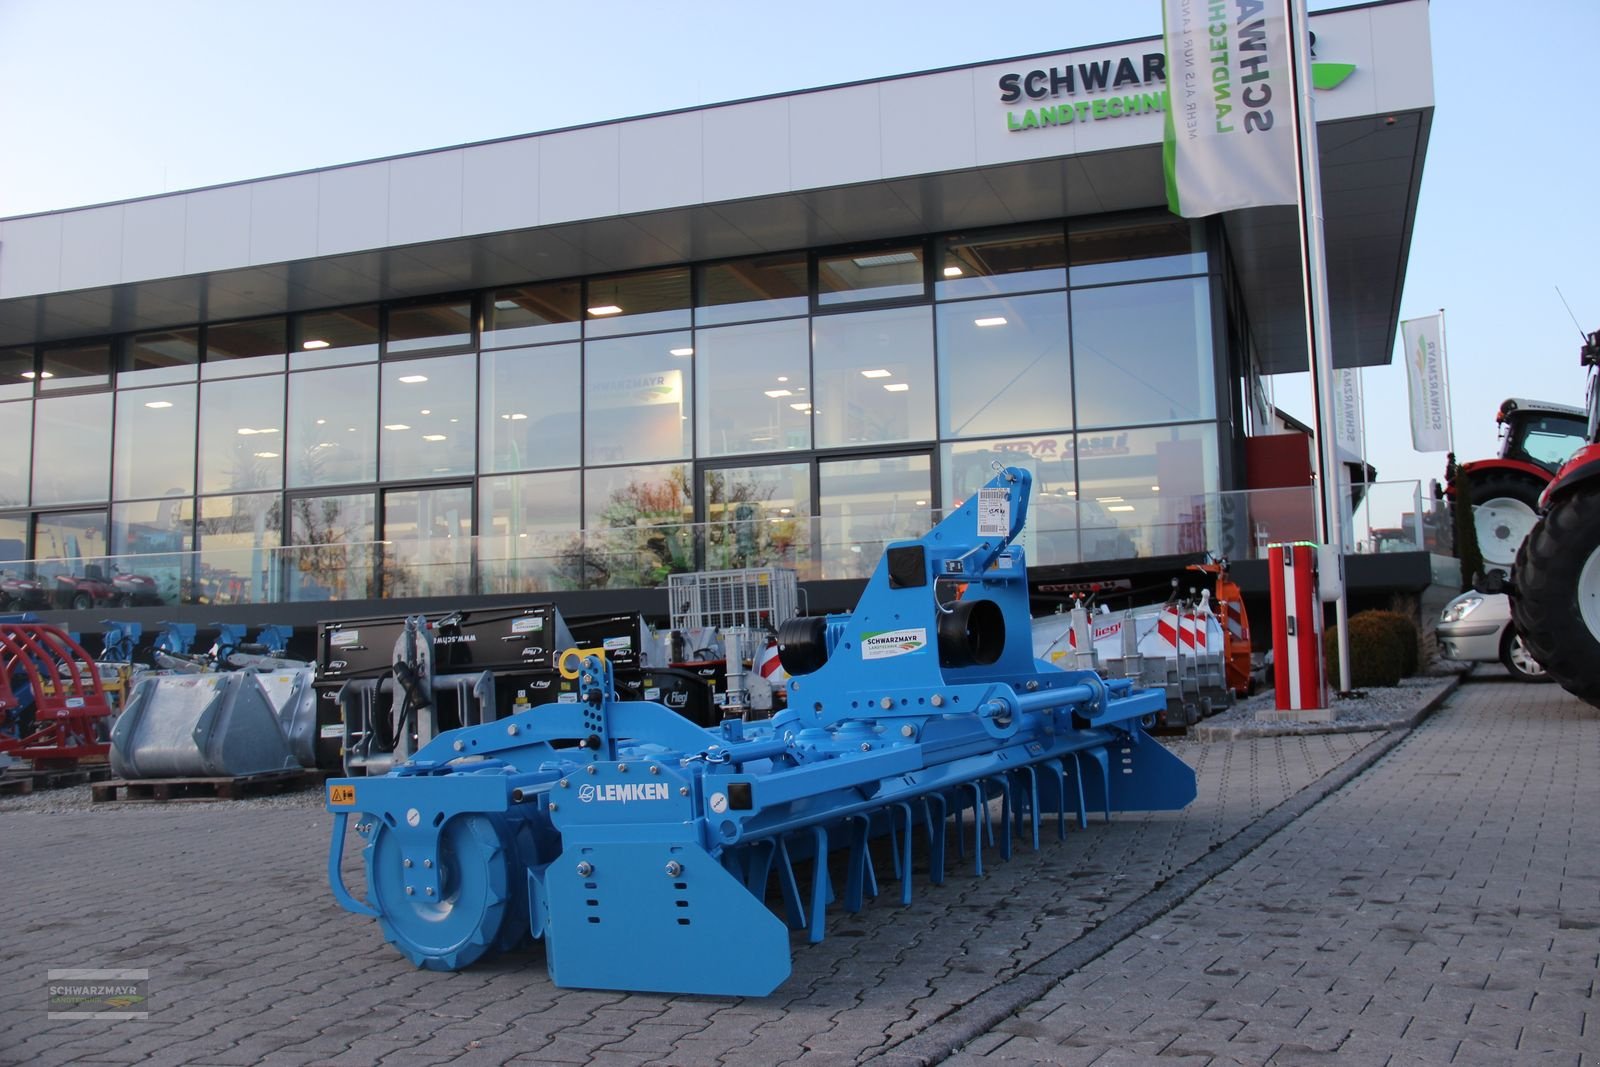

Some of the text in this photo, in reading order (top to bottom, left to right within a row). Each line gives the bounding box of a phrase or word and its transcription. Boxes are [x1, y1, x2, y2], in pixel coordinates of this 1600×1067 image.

[998, 52, 1167, 104] SCHWAR
[1007, 91, 1168, 132] LANDTECHNI
[1095, 621, 1122, 637] liegl
[867, 635, 917, 645] SCHWARZMAYR
[666, 691, 689, 708] Fliegl
[596, 783, 669, 805] LEMKEN
